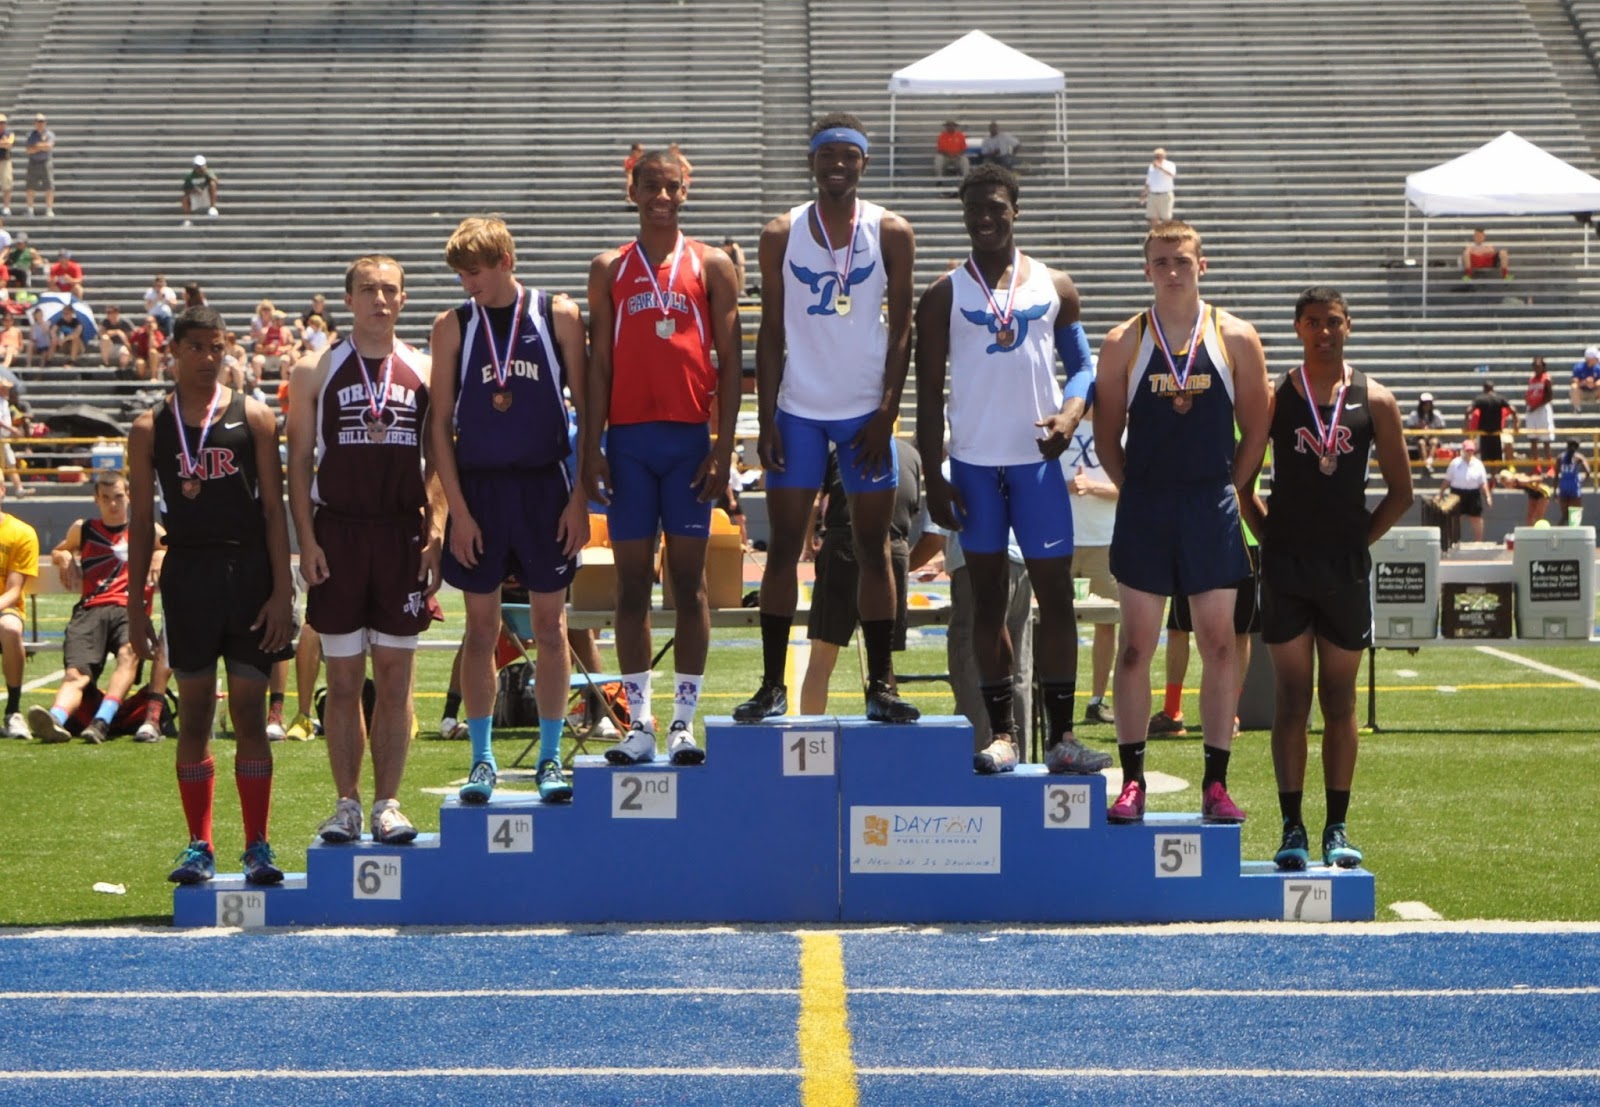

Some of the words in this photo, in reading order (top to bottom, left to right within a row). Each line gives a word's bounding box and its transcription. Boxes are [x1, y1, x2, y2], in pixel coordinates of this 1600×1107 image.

[481, 359, 540, 385] ETON
[338, 430, 418, 447] HILLCBERS
[1294, 424, 1355, 458] NR
[176, 447, 239, 480] NR
[790, 737, 826, 771] 1st
[619, 776, 669, 811] 2nd
[1048, 789, 1086, 824] 3rd
[492, 819, 529, 848] 4th
[1160, 839, 1197, 873] 5th
[357, 860, 398, 895] 6th
[222, 894, 261, 926] 8th
[1289, 885, 1327, 919] 7th
